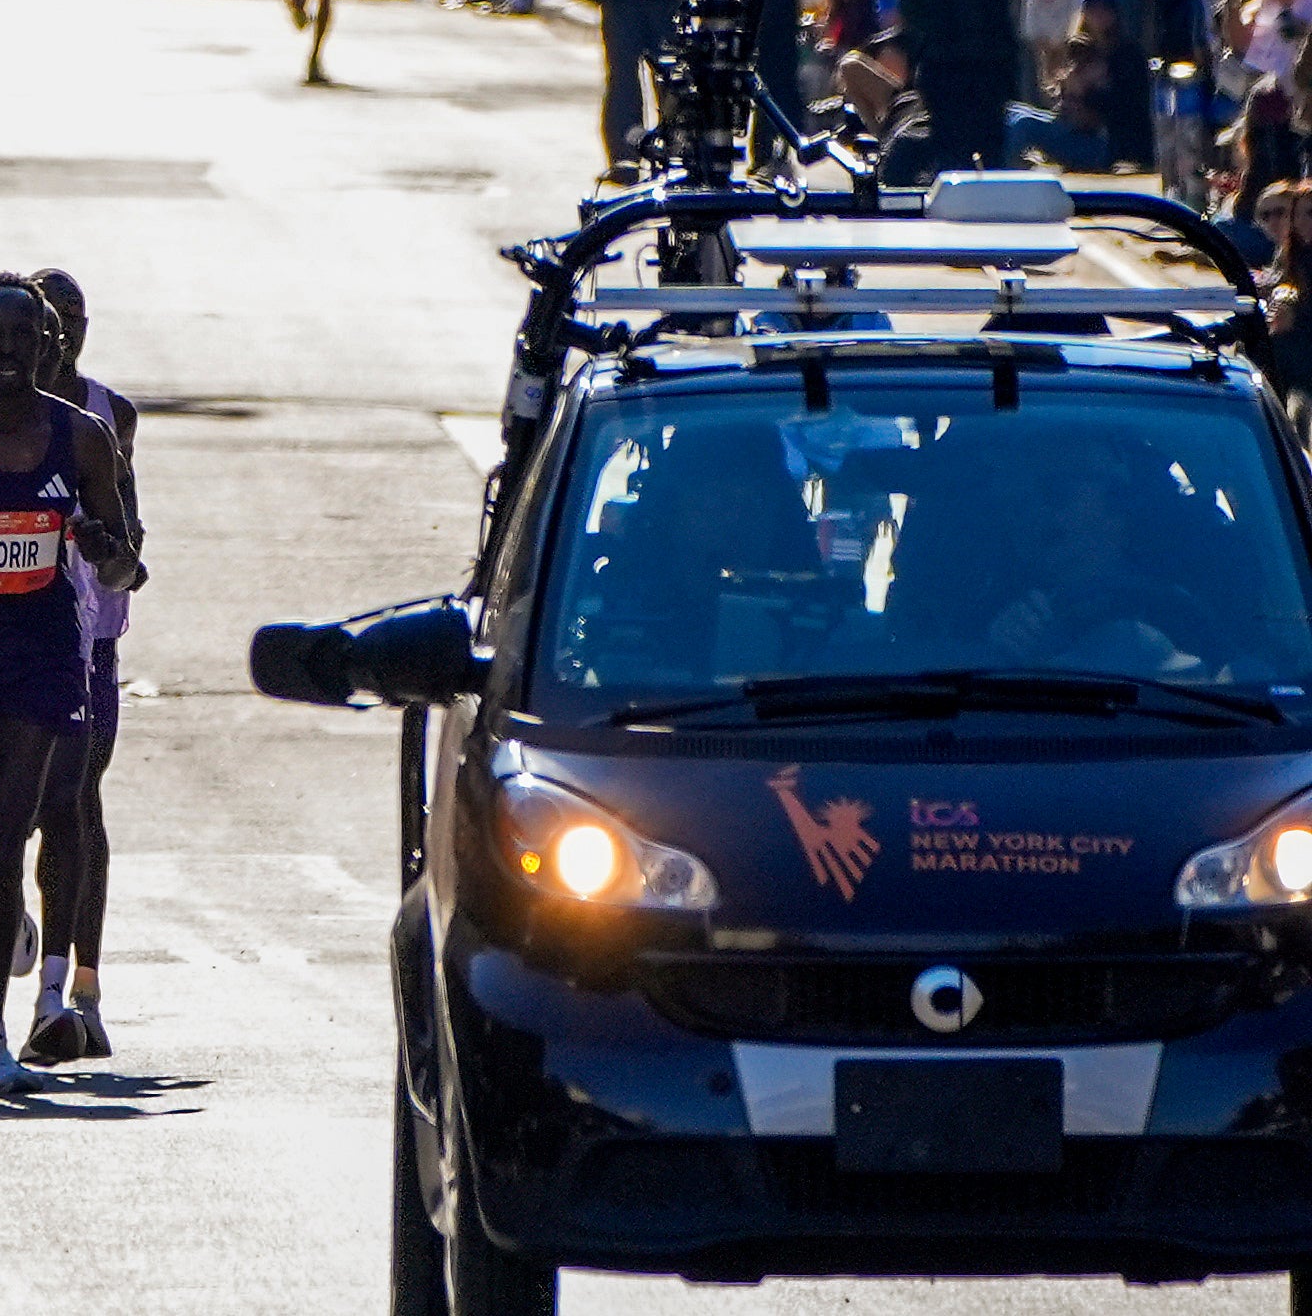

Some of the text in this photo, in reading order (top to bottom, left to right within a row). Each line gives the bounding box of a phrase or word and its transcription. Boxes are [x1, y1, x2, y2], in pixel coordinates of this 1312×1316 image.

[910, 833, 1135, 854] NEW YORK CITY
[911, 853, 1081, 874] MARATHON
